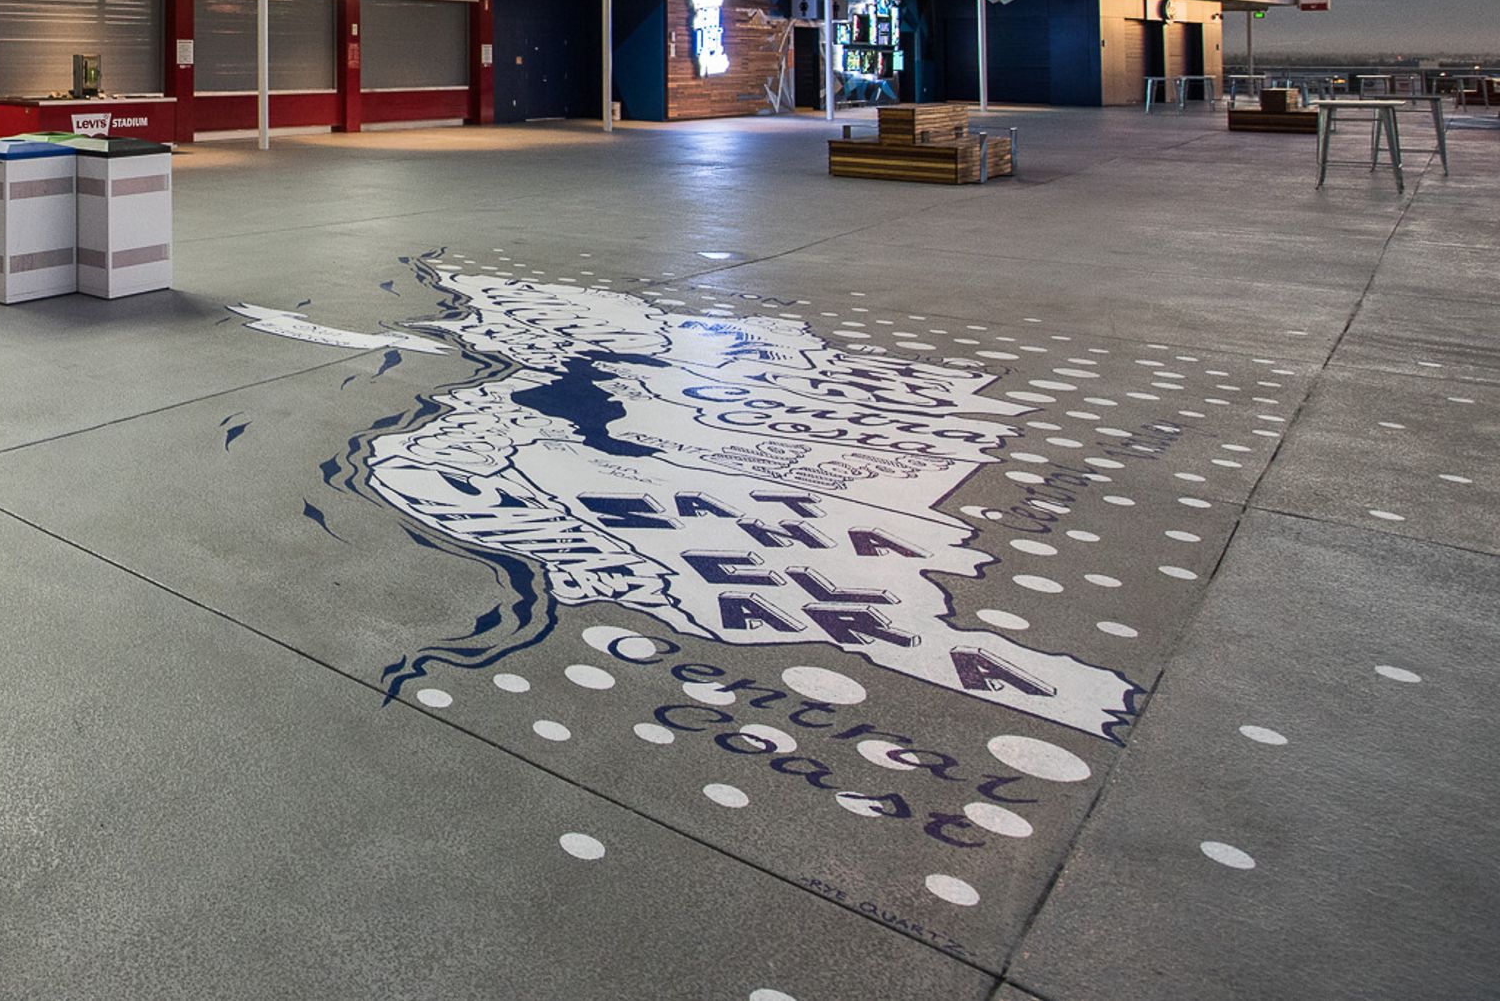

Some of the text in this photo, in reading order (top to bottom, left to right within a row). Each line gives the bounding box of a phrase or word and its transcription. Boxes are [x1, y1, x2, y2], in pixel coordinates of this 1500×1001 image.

[112, 116, 148, 129] STADIUM
[682, 385, 997, 444] Contra
[717, 410, 940, 453] Costa
[607, 635, 1039, 804] Central
[653, 703, 986, 848] Coast
